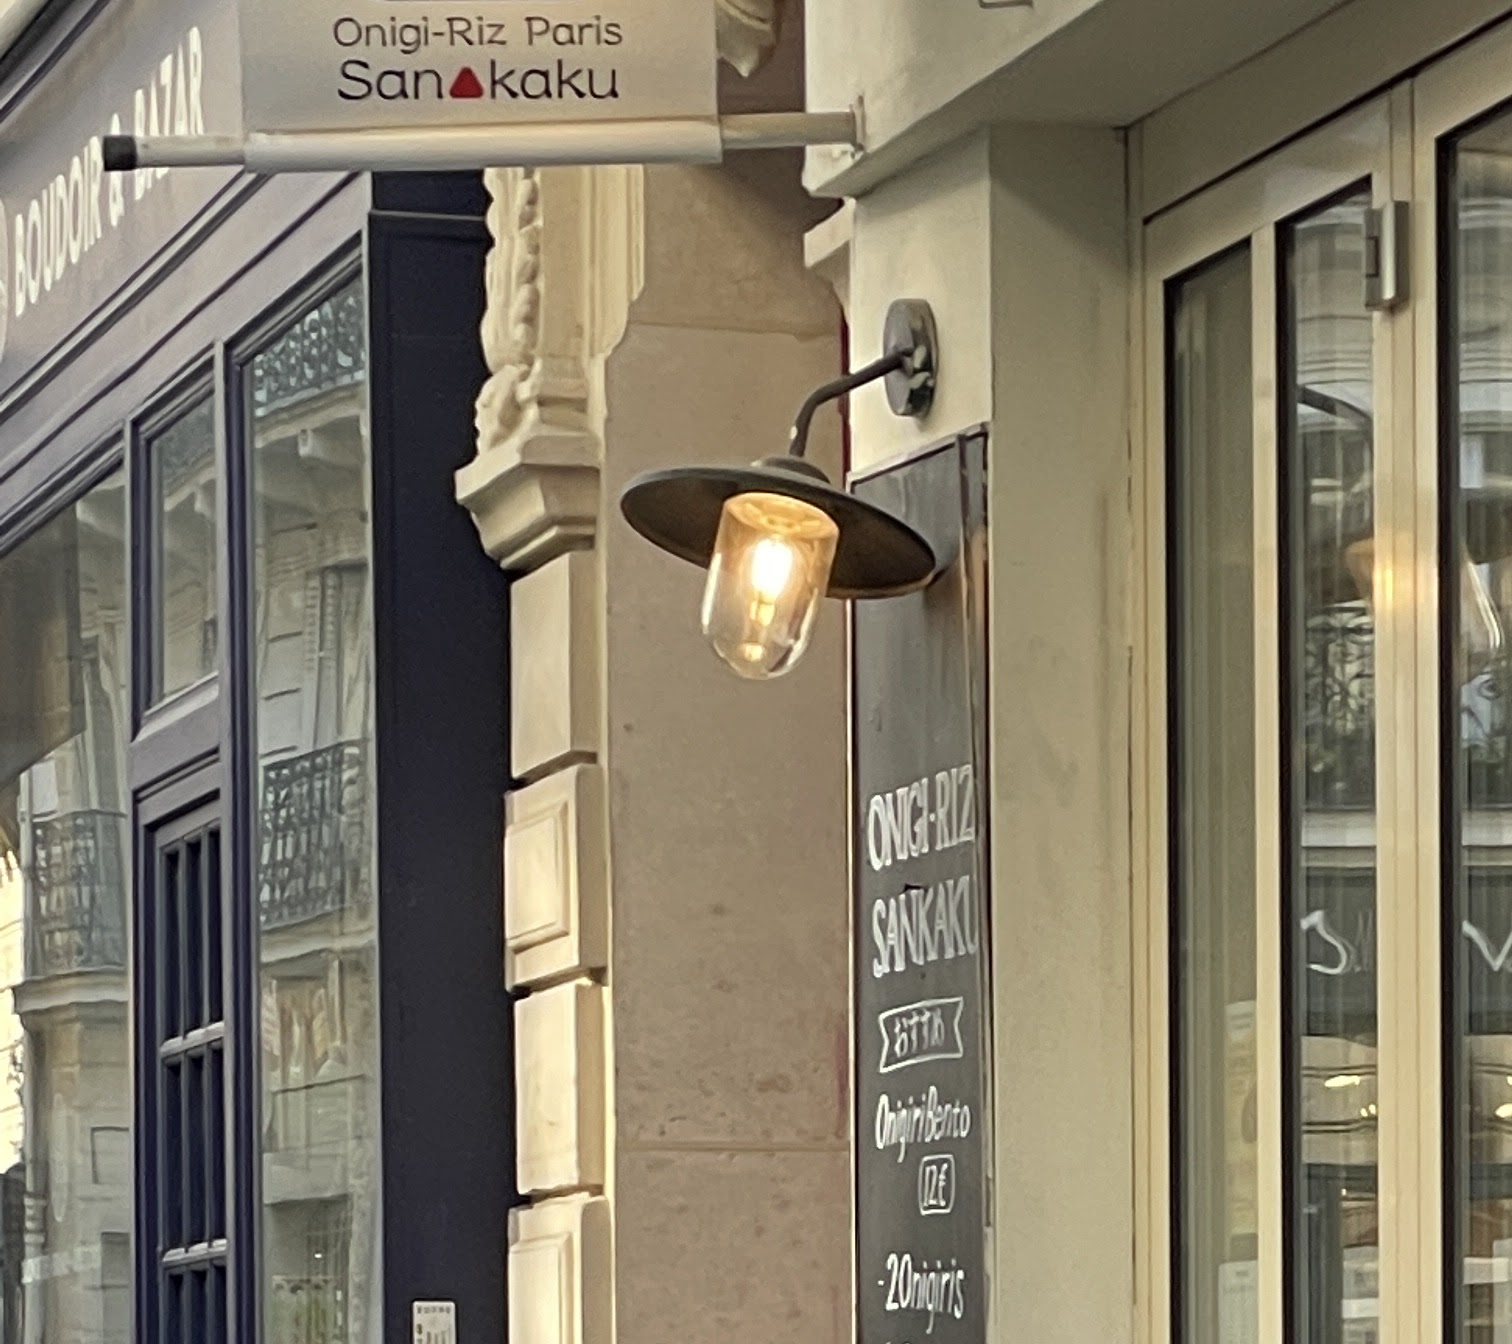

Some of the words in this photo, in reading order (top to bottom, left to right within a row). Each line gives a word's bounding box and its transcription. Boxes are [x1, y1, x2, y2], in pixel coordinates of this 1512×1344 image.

[333, 16, 507, 55] Onigi-Riz
[524, 14, 623, 46] Paris
[15, 136, 101, 317] BOUDOIR
[108, 113, 124, 227] &
[134, 26, 204, 201] BAZAR
[867, 764, 977, 870] ONIGI-RIZ
